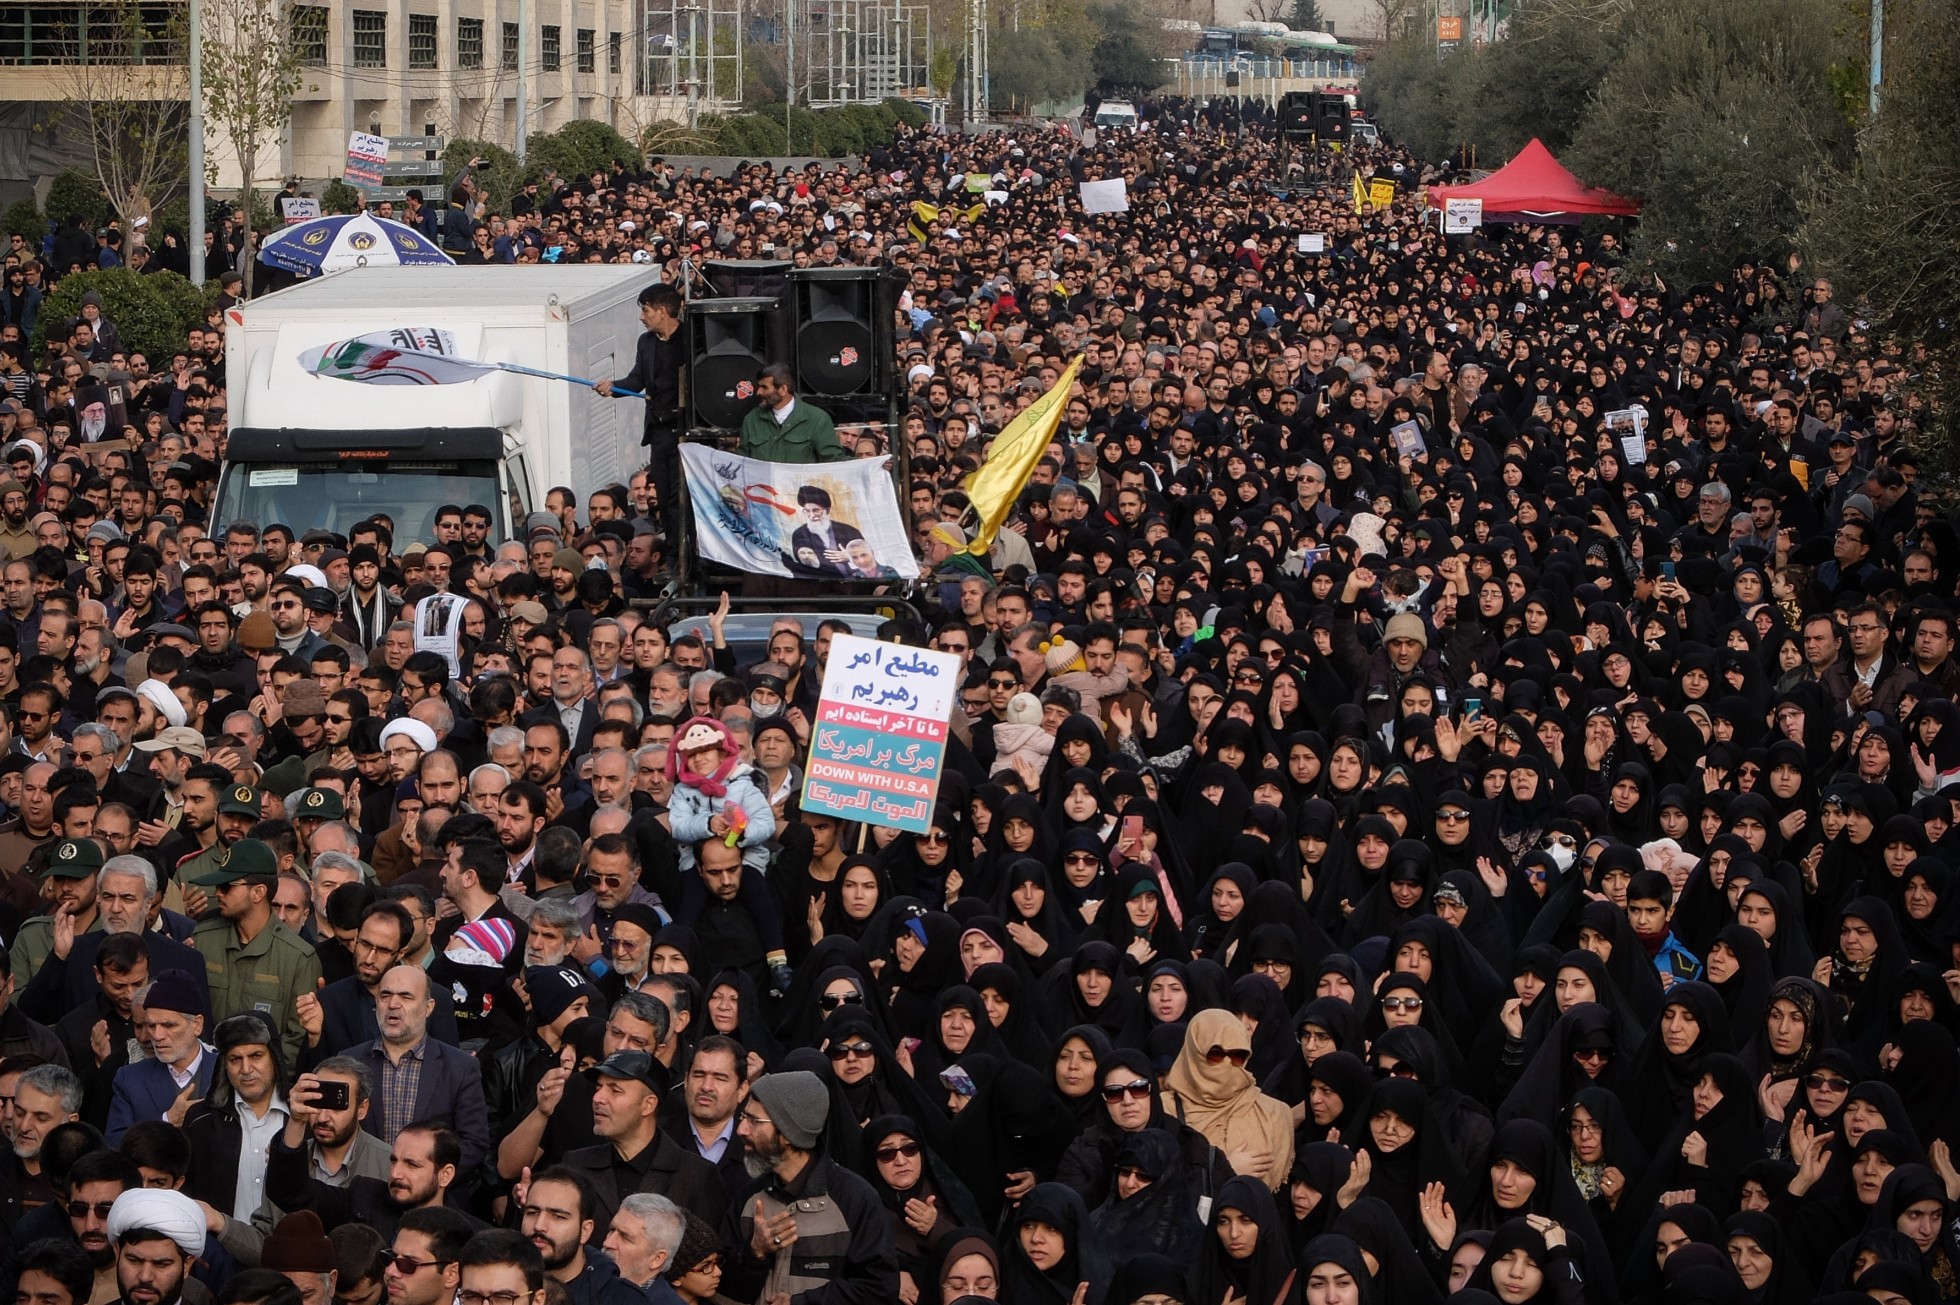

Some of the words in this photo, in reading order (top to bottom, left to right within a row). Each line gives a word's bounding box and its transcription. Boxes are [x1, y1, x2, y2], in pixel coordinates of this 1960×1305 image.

[846, 646, 883, 669] امر
[884, 652, 939, 677] مطیع
[852, 682, 919, 711] رهبریم
[825, 706, 844, 720] ایم
[846, 711, 888, 730] ایستاده
[888, 717, 916, 732] آخر
[916, 720, 926, 733] تا
[928, 722, 939, 736] ما
[817, 729, 873, 760] امریکا
[870, 748, 892, 768] بر
[896, 744, 935, 773] مرگ
[812, 763, 854, 780] DOWN
[858, 771, 891, 787] WITH
[894, 777, 929, 795] U.S.A
[808, 781, 871, 810] لامریکا
[872, 797, 927, 820] الموت
